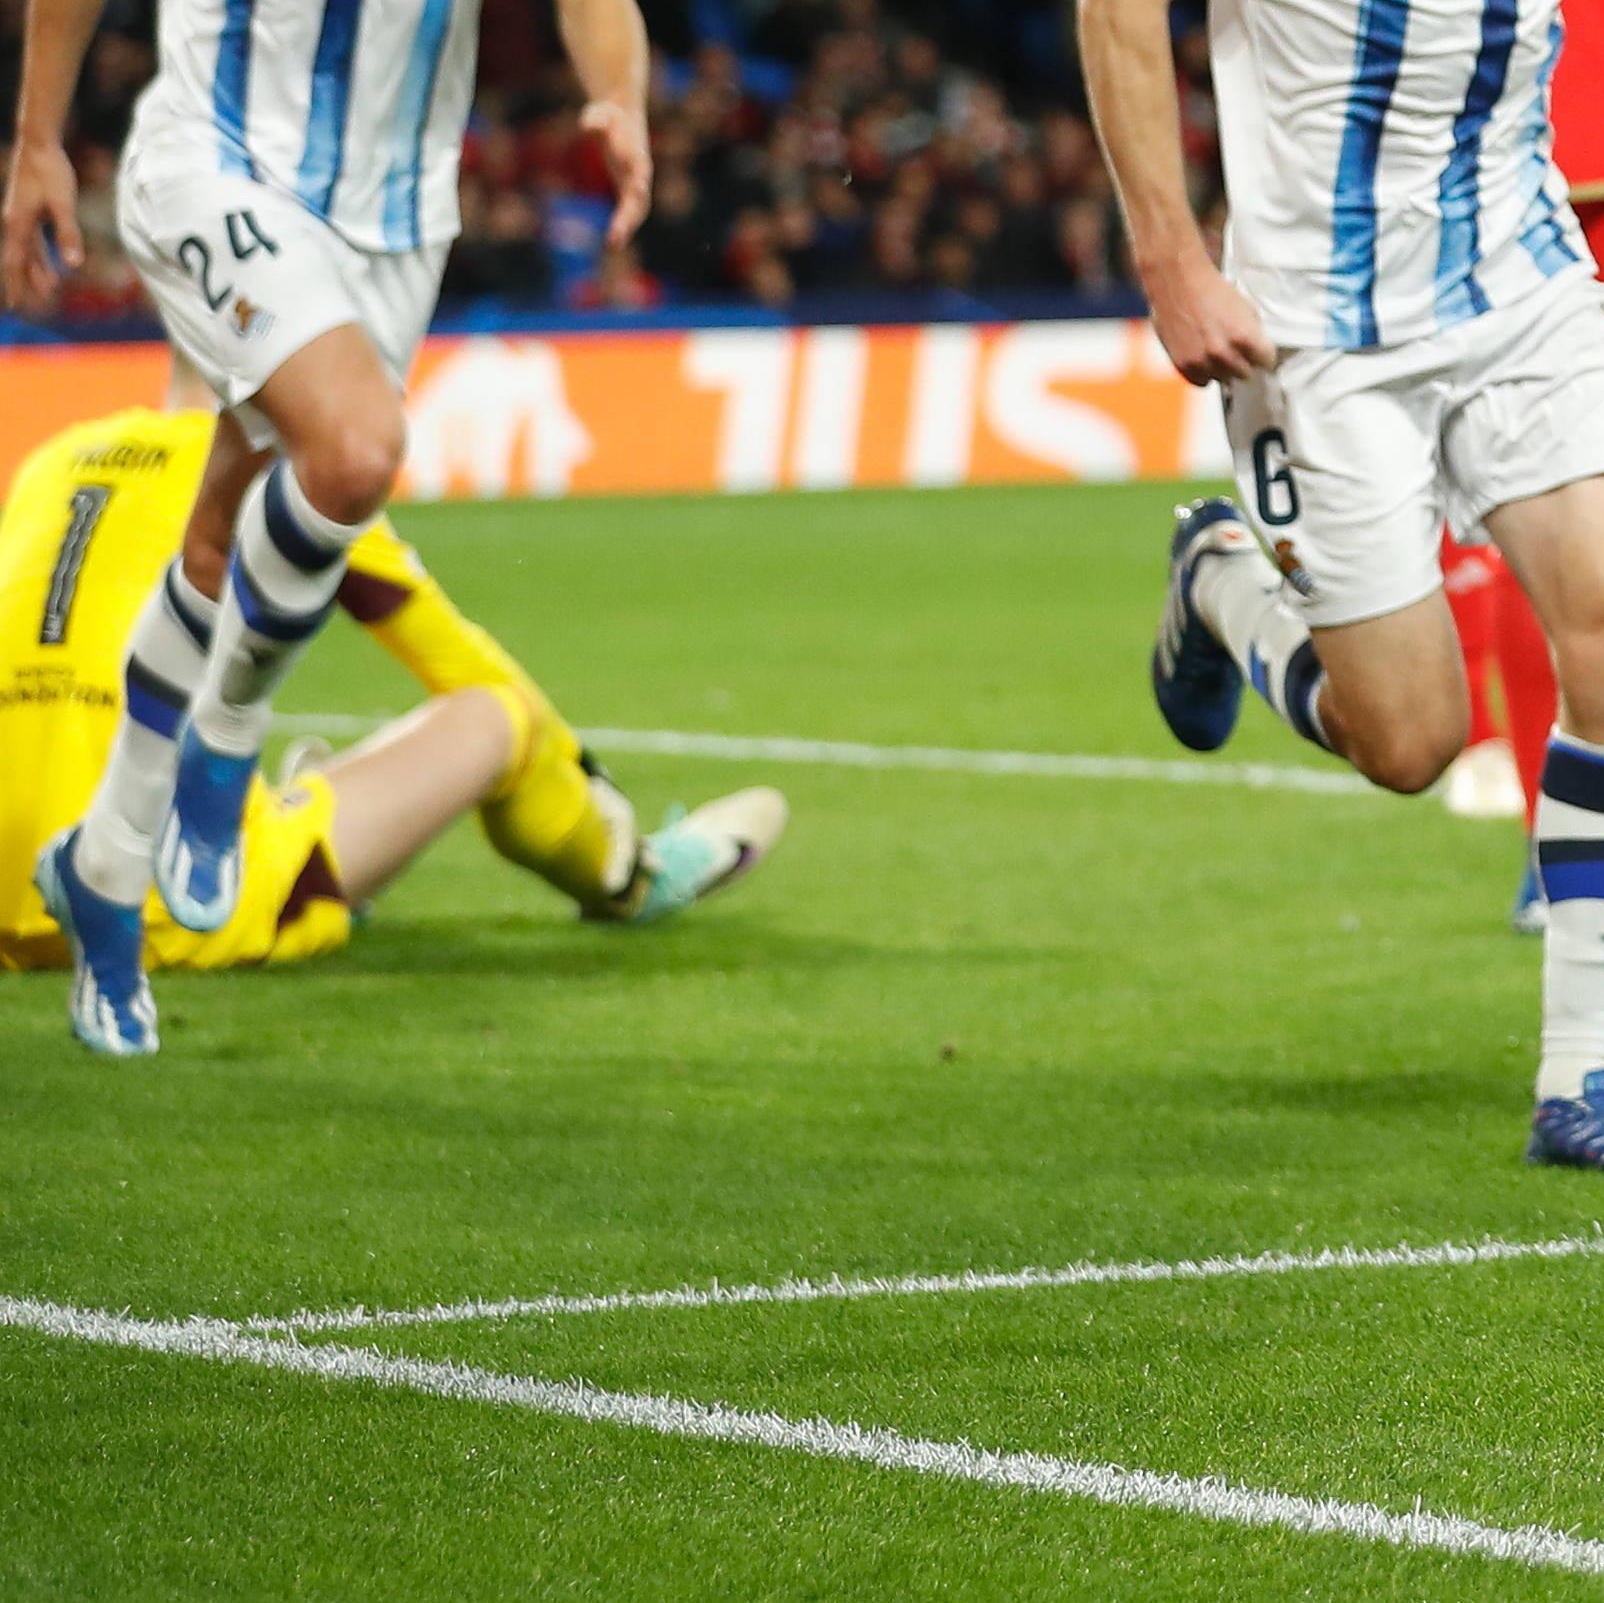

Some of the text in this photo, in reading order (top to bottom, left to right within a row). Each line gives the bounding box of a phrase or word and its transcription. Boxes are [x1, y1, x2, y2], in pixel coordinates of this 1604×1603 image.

[178, 210, 281, 312] 24
[1253, 428, 1299, 526] 6
[39, 483, 113, 645] 1
